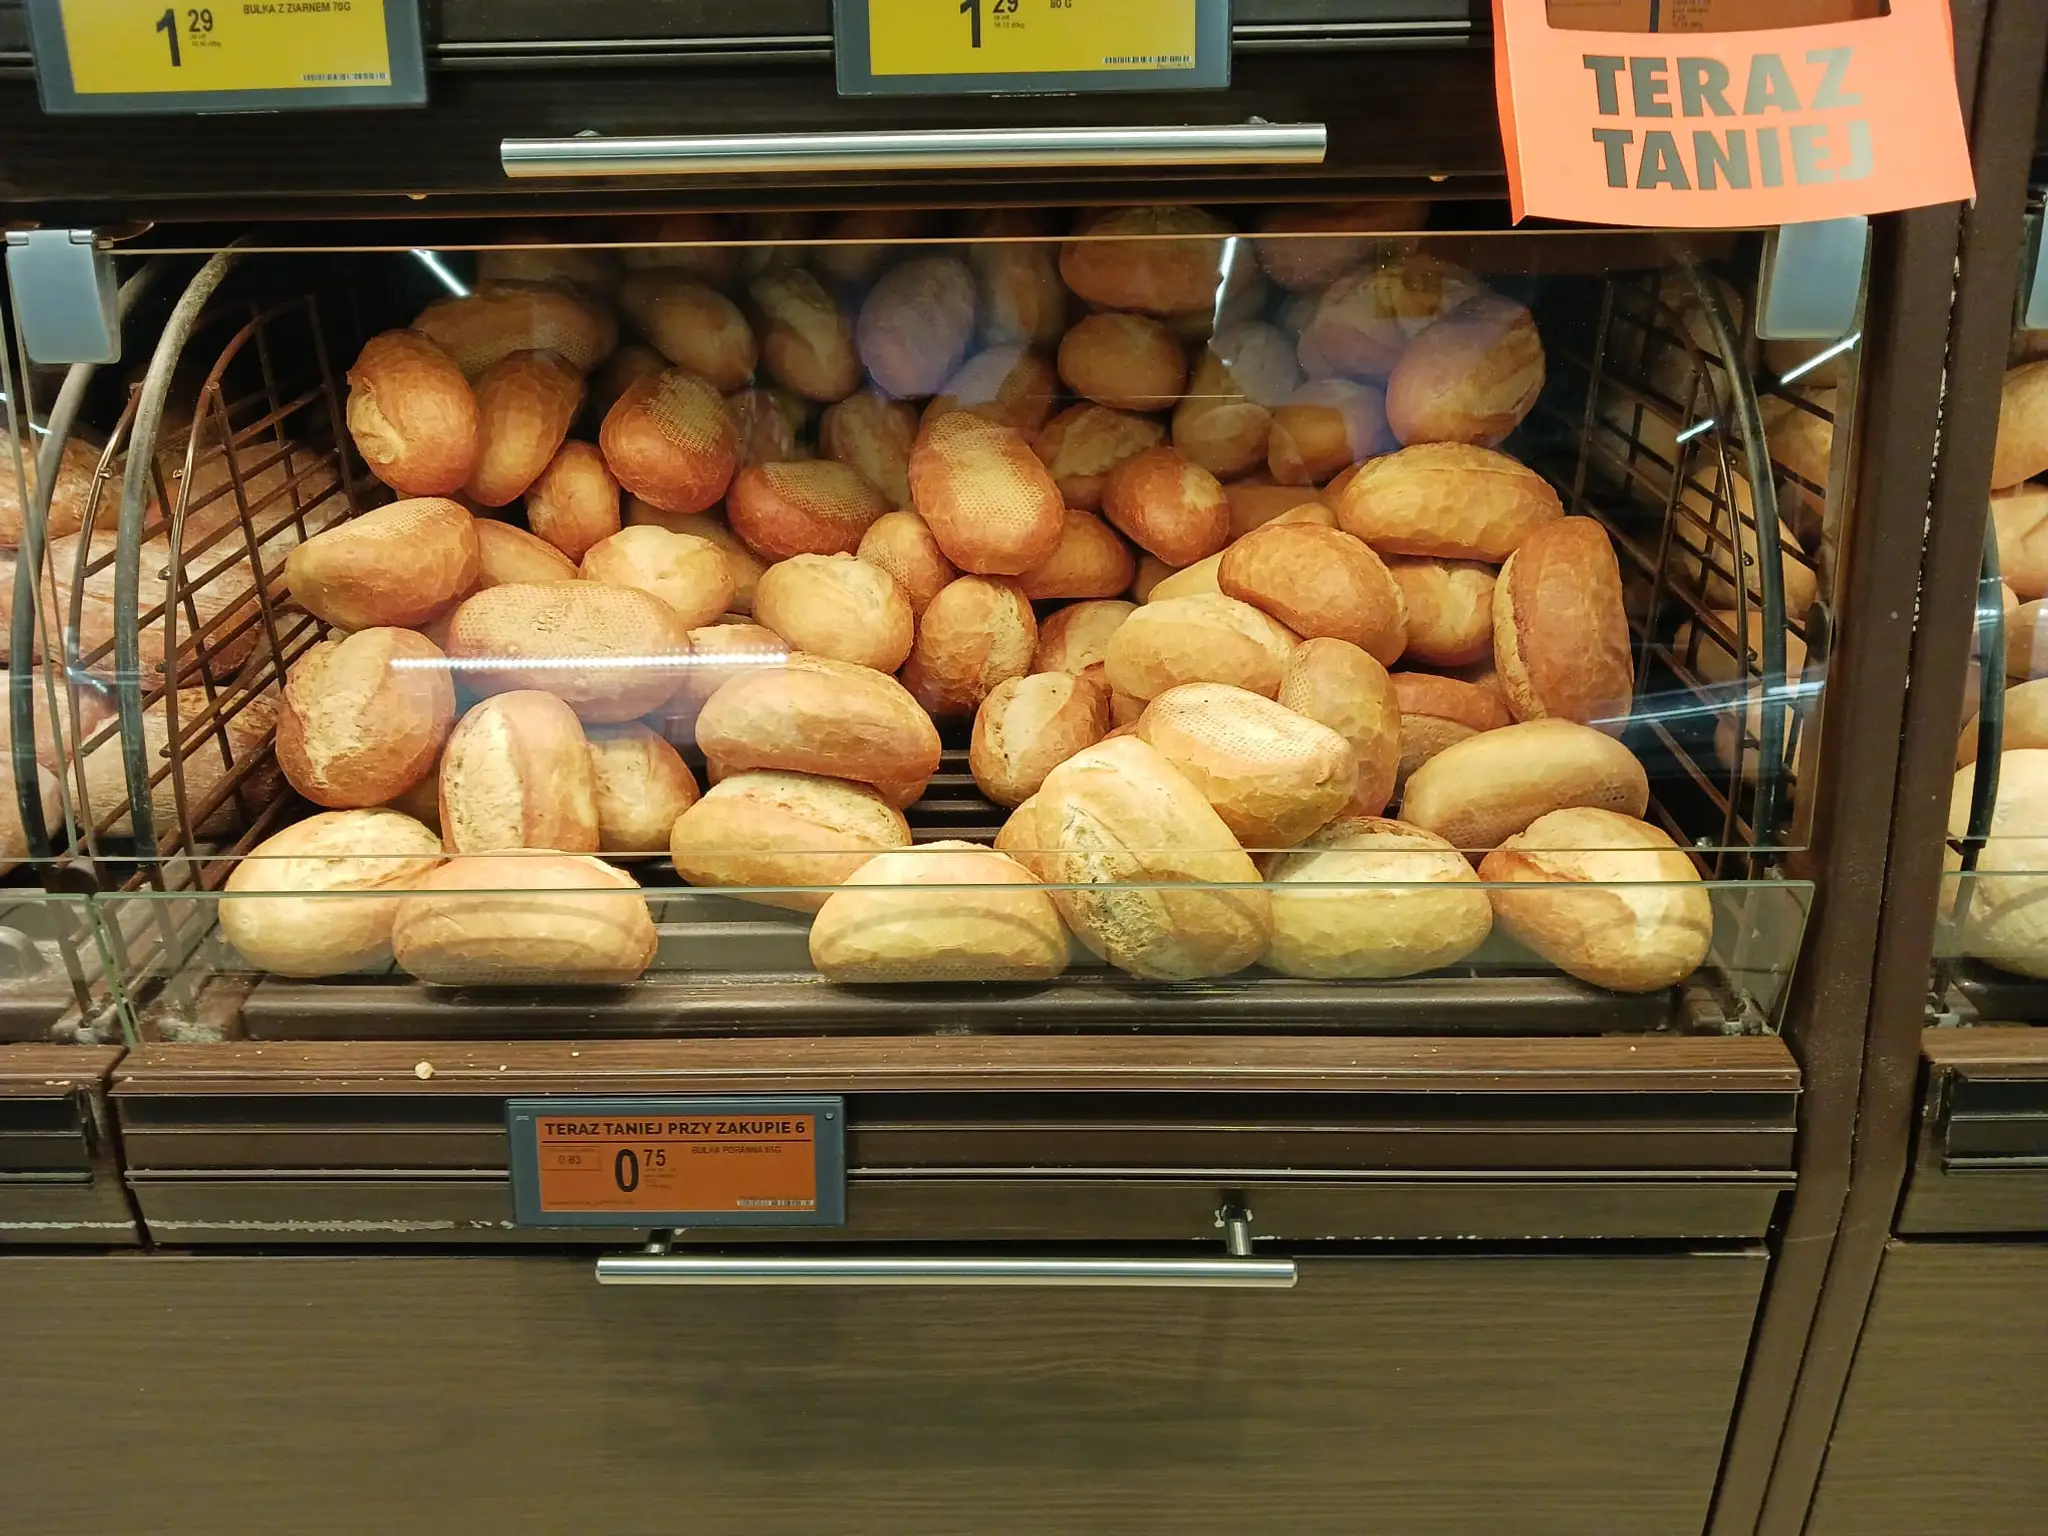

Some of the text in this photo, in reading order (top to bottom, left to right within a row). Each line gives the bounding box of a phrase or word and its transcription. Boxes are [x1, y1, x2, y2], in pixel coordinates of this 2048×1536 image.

[286, 2, 331, 13] ZIARNEM
[333, 1, 352, 11] 70G
[960, 0, 981, 48] 1
[156, 8, 213, 67] 1 29
[1583, 46, 1863, 118] TERAZ
[1592, 119, 1875, 191] TANIEJ
[545, 1120, 805, 1136] TERAZ TANIEJ PRZY ZAKUPIE 6
[614, 1148, 666, 1193] 0 75
